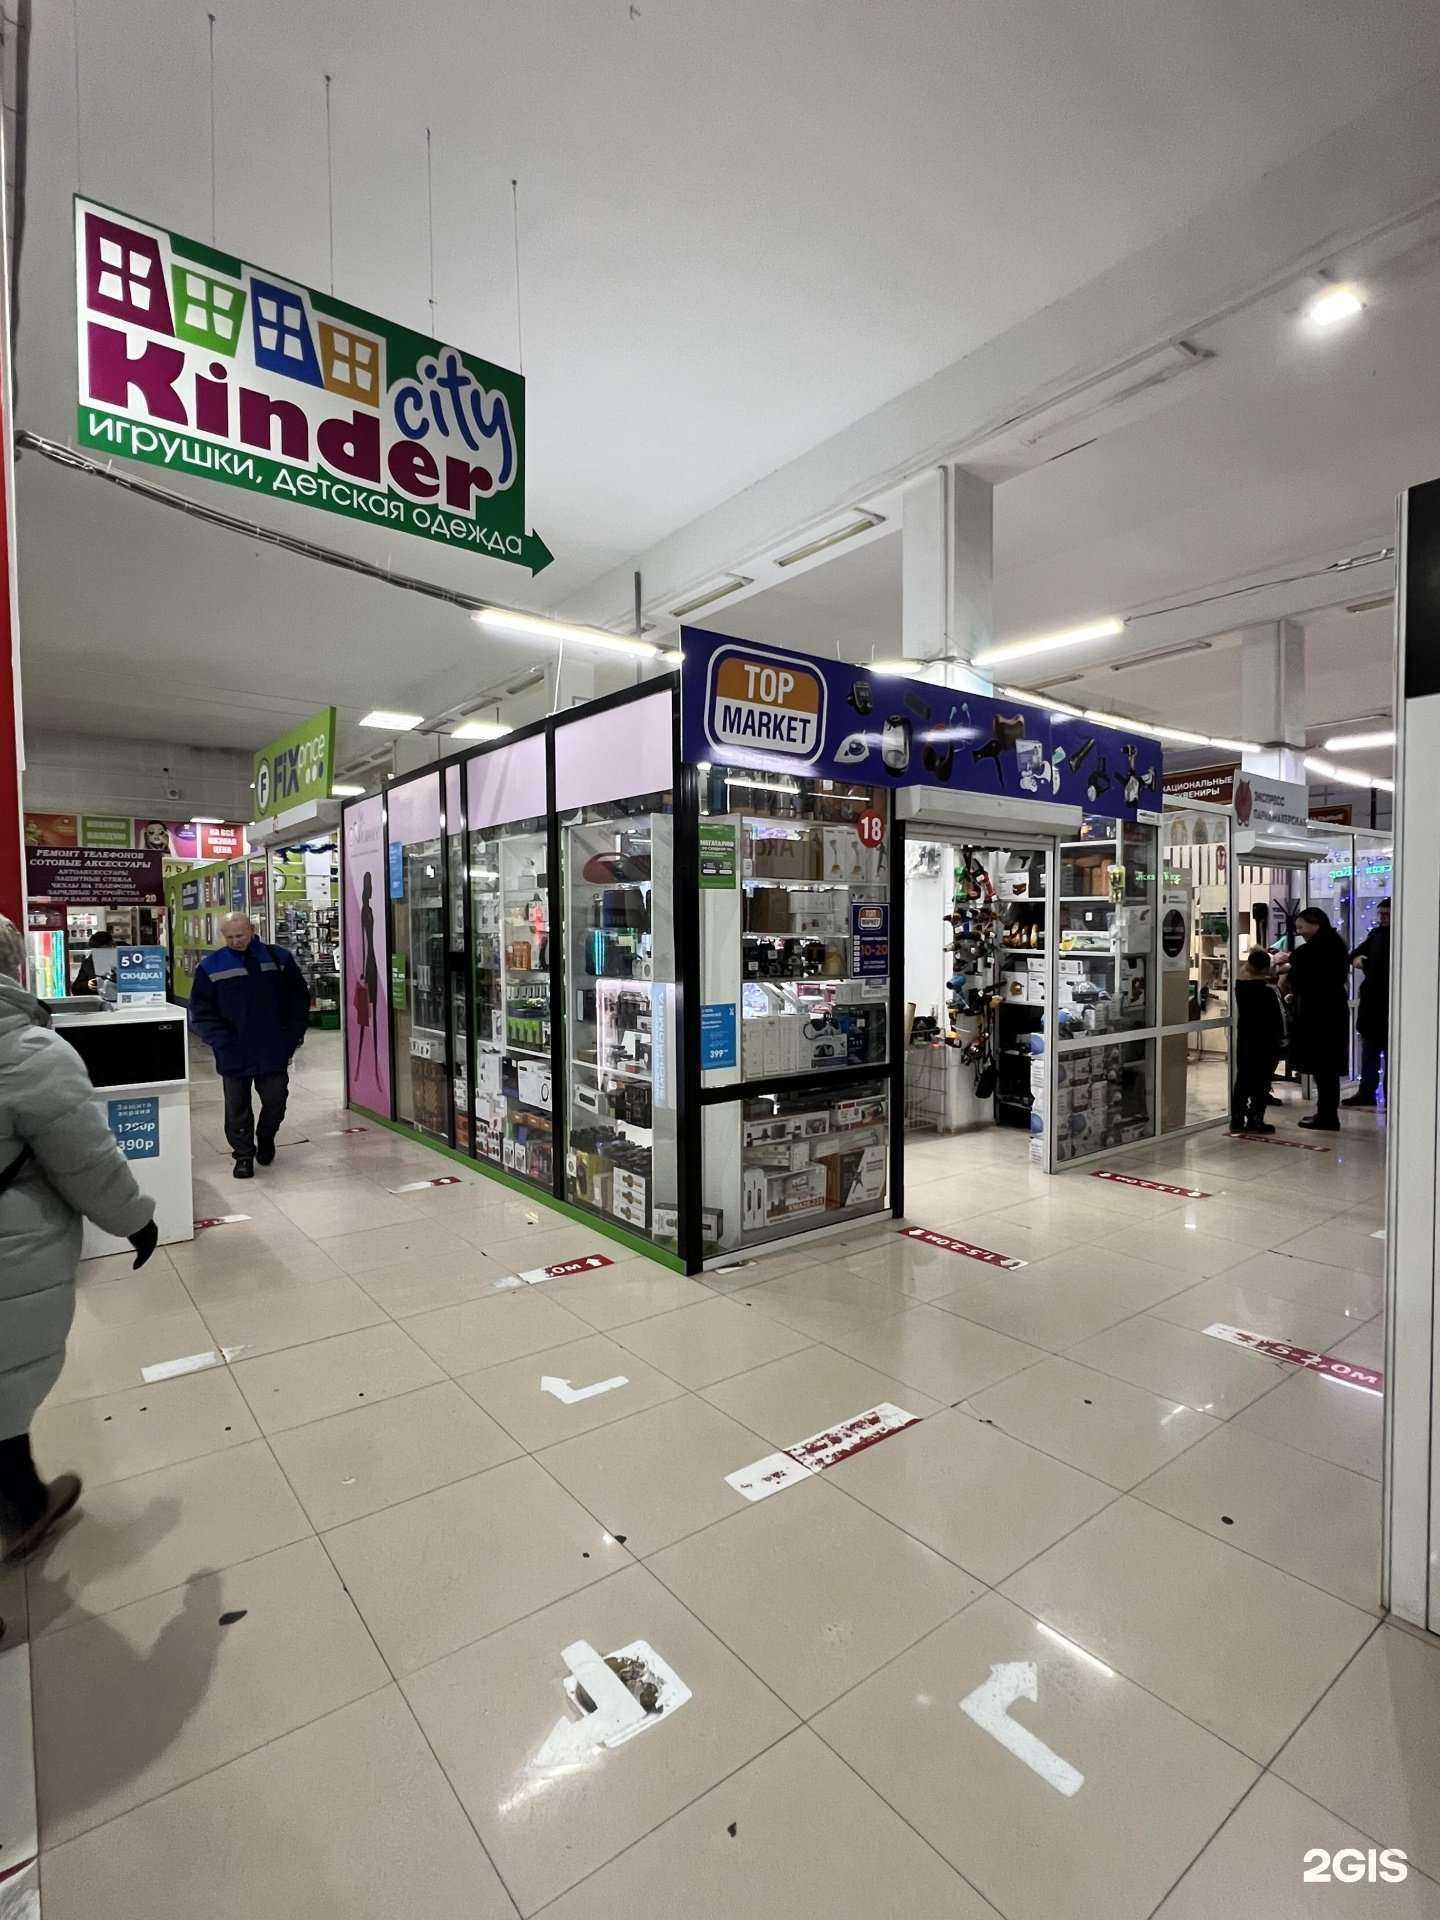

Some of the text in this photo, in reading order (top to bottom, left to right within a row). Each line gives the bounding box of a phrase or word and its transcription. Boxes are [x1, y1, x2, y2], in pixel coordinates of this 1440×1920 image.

[88, 321, 493, 511] Kinder
[394, 353, 511, 483] city
[89, 413, 522, 555] игрушки, детская одежда
[744, 664, 794, 704] TOP
[722, 704, 811, 744] MARKET
[860, 816, 881, 841] 18
[30, 859, 151, 868] СОТОВЫЕ АКСЕССУАРЫ
[36, 849, 144, 859] РЕМОНТ ТЕЛЕФОНОВ
[120, 971, 163, 981] СКИДКА!
